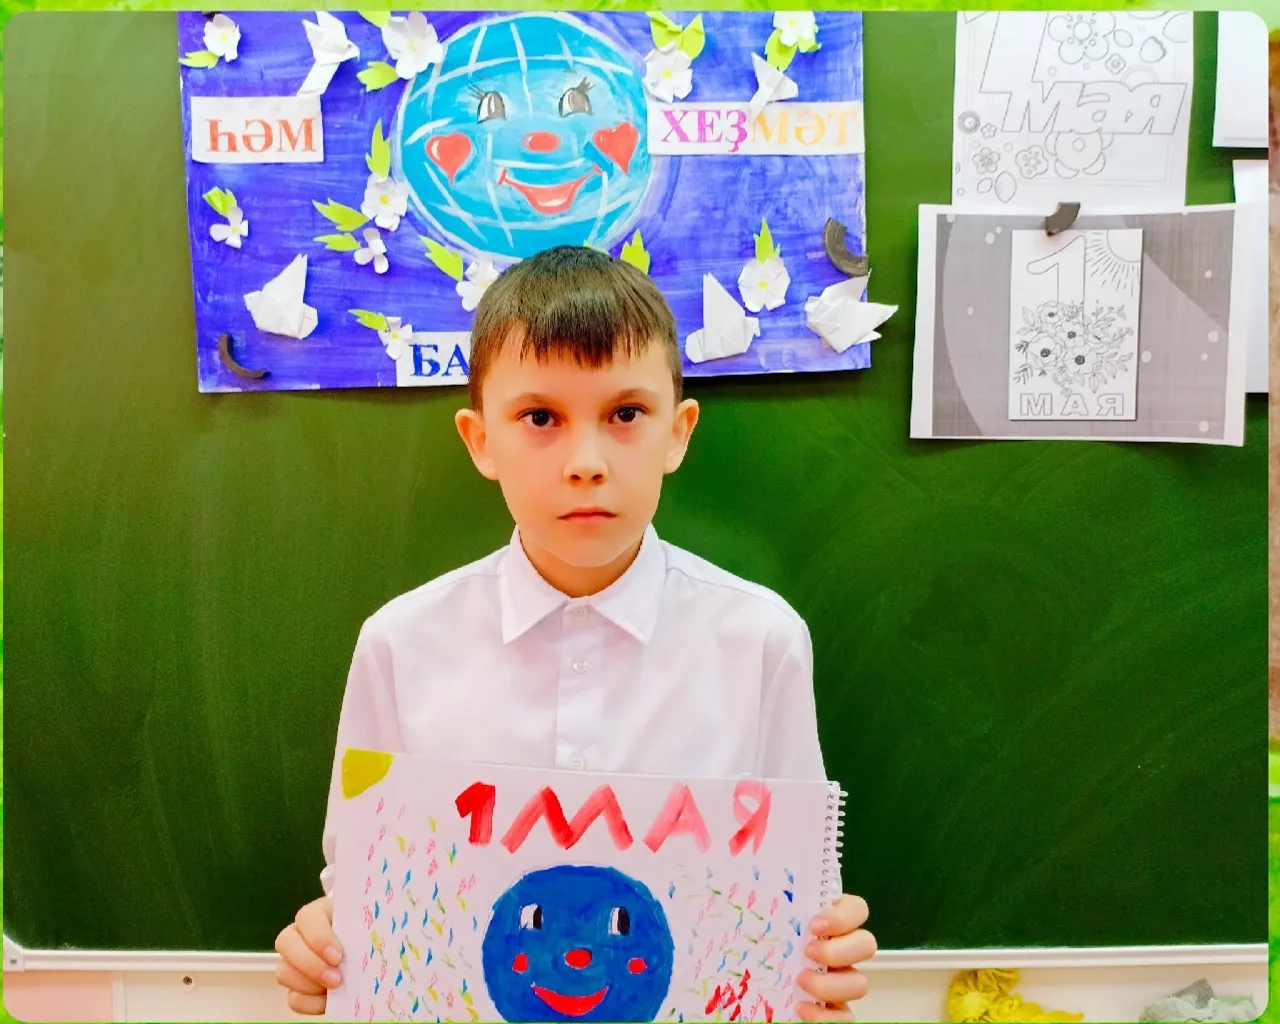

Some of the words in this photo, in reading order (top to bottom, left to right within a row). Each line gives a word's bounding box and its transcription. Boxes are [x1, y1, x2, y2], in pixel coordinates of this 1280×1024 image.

[409, 343, 469, 377] БА
[1020, 393, 1124, 416] МАЯ
[455, 781, 496, 846] 1
[500, 780, 772, 856] МАЯ
